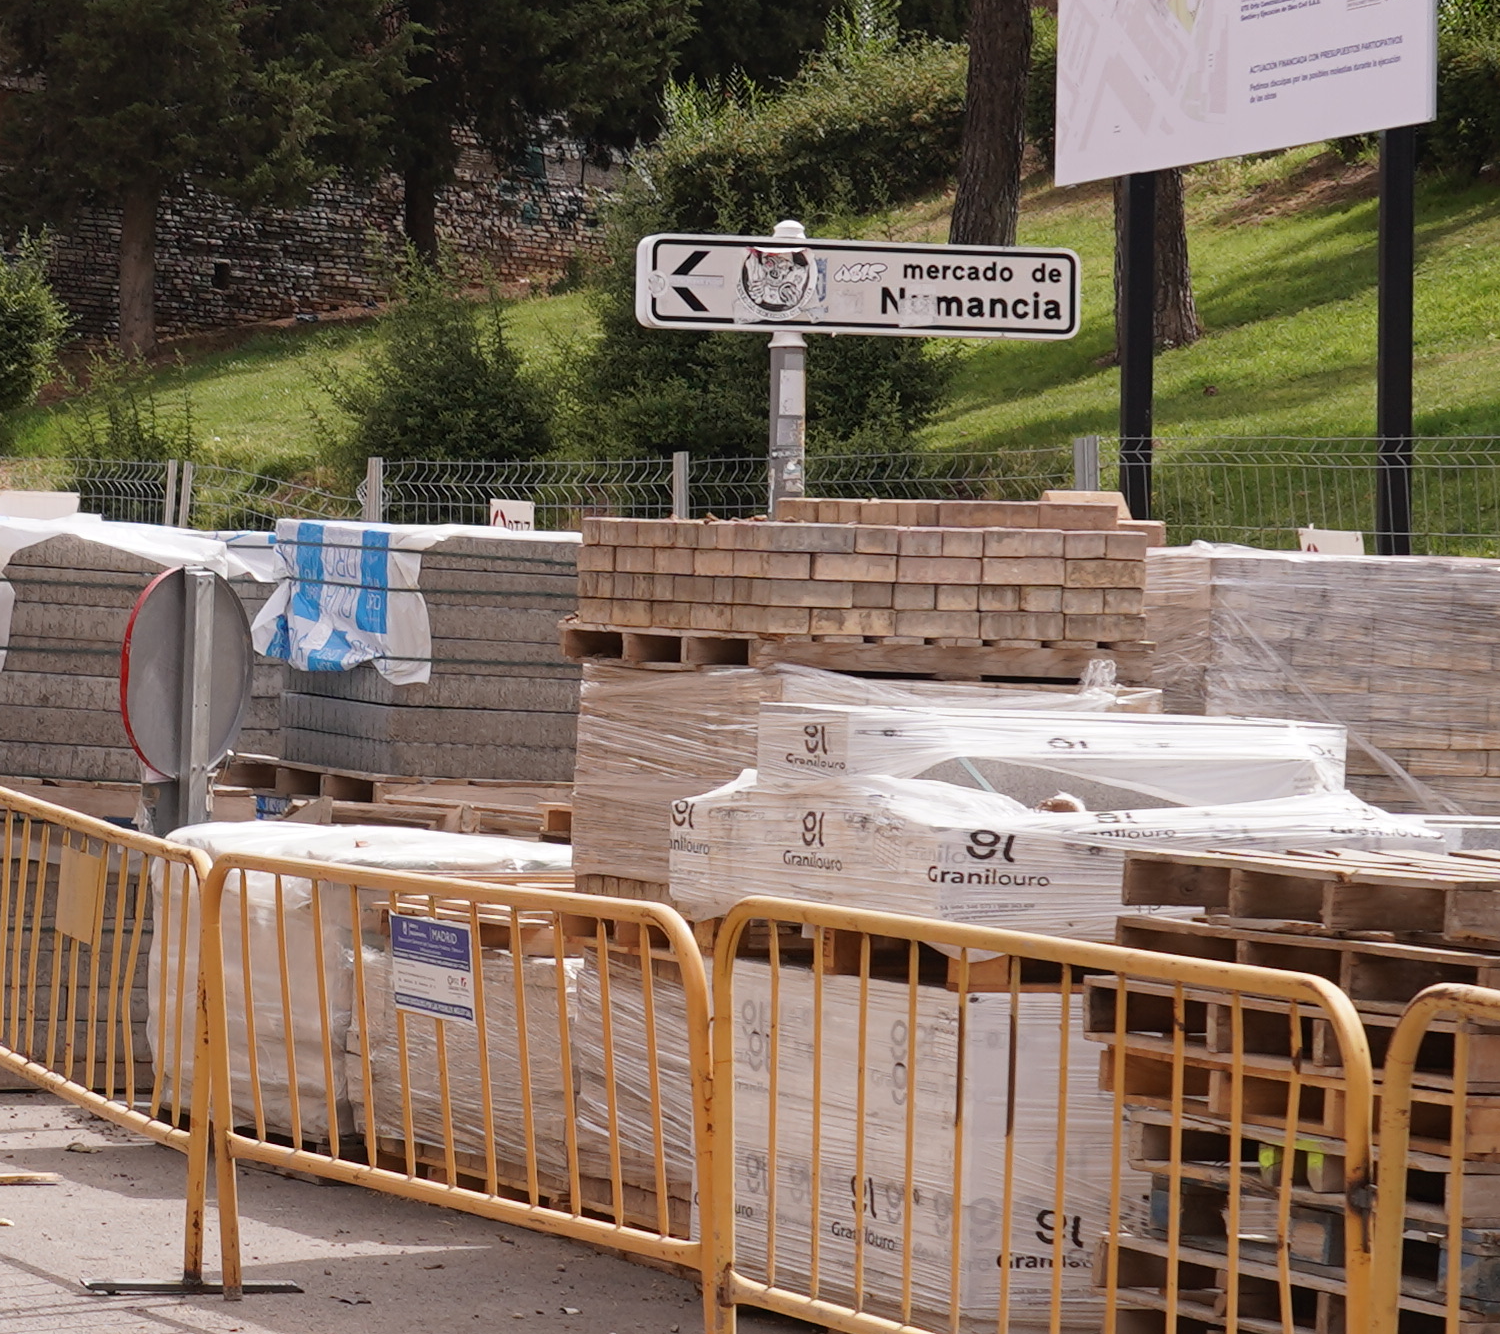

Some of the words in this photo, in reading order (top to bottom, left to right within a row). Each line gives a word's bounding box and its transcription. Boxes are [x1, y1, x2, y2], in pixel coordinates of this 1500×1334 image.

[903, 262, 1013, 281] mercado
[1032, 263, 1062, 283] de
[881, 287, 1062, 320] Nmancia
[783, 850, 843, 872] Granilouro
[927, 866, 1051, 888] Granilouro
[431, 929, 458, 945] MADRID
